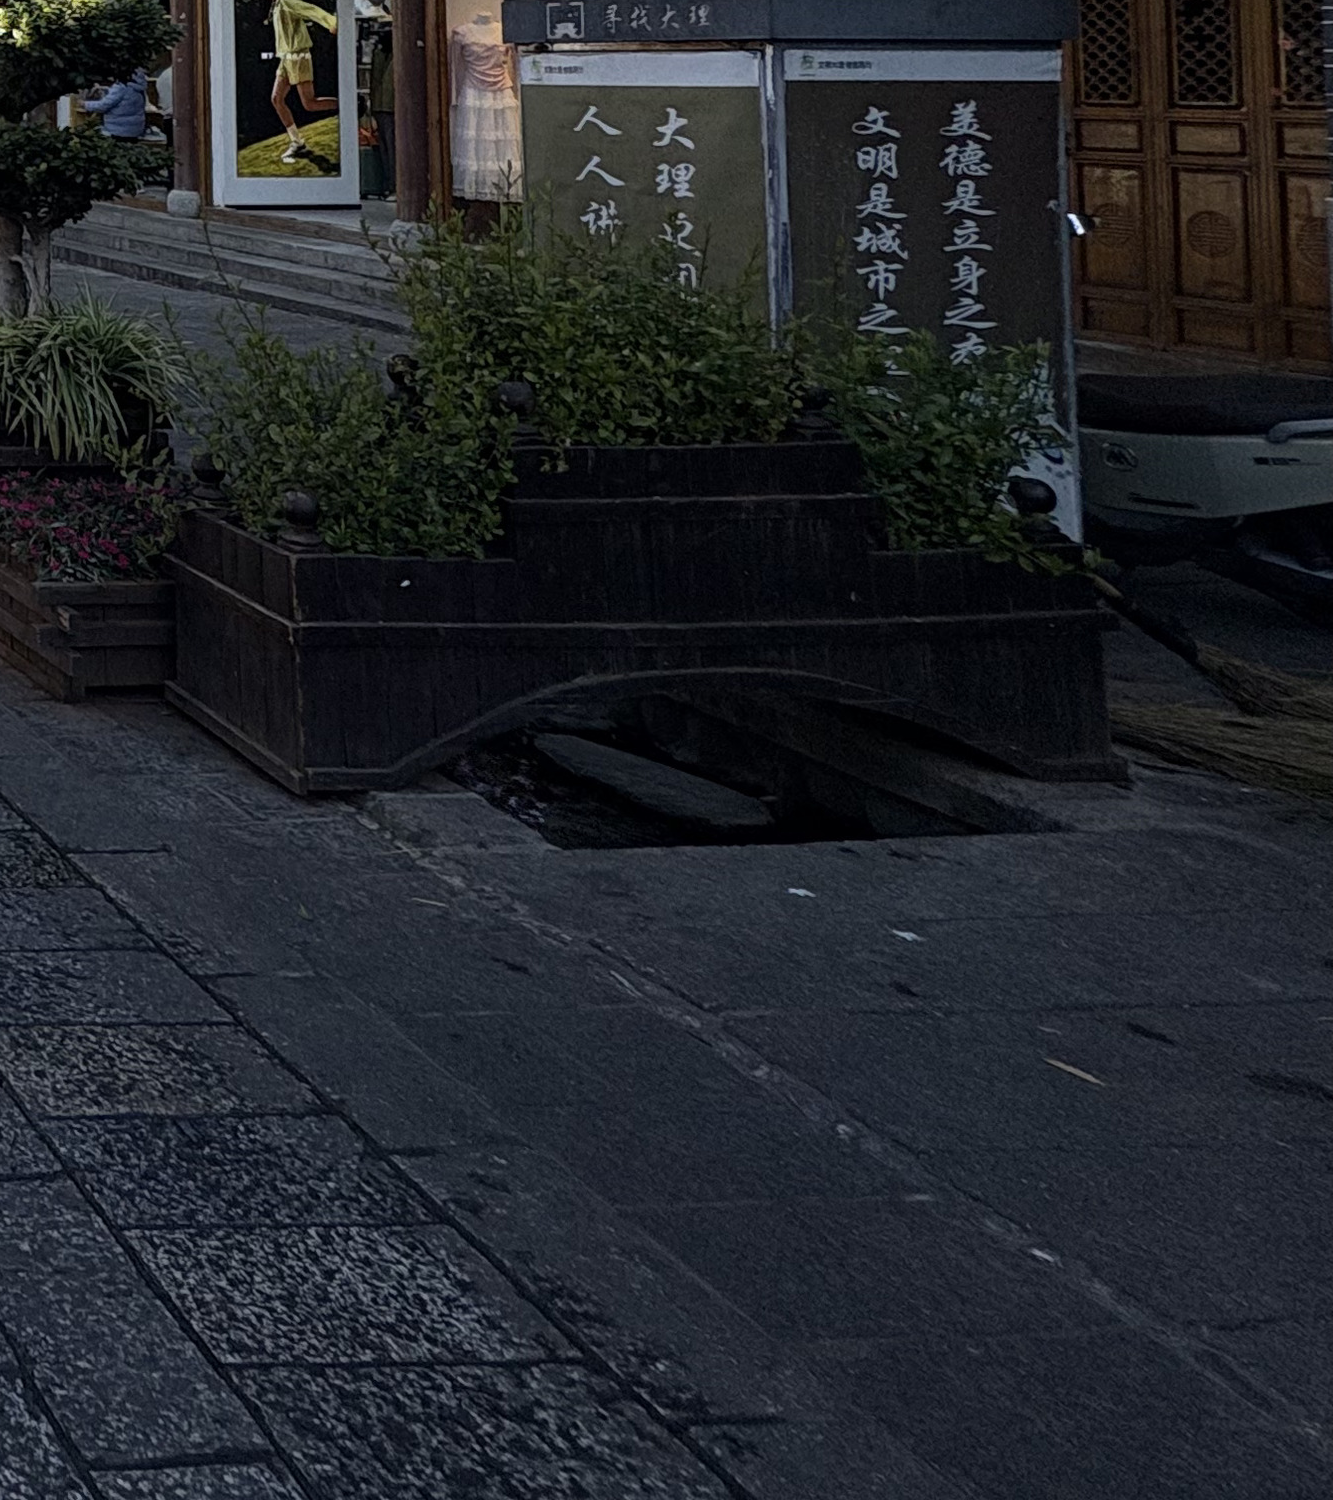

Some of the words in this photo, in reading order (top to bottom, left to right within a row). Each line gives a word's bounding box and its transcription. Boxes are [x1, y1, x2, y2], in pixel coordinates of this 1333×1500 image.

[603, 3, 711, 34] 寻找大理
[851, 106, 911, 377] 文明是城市之
